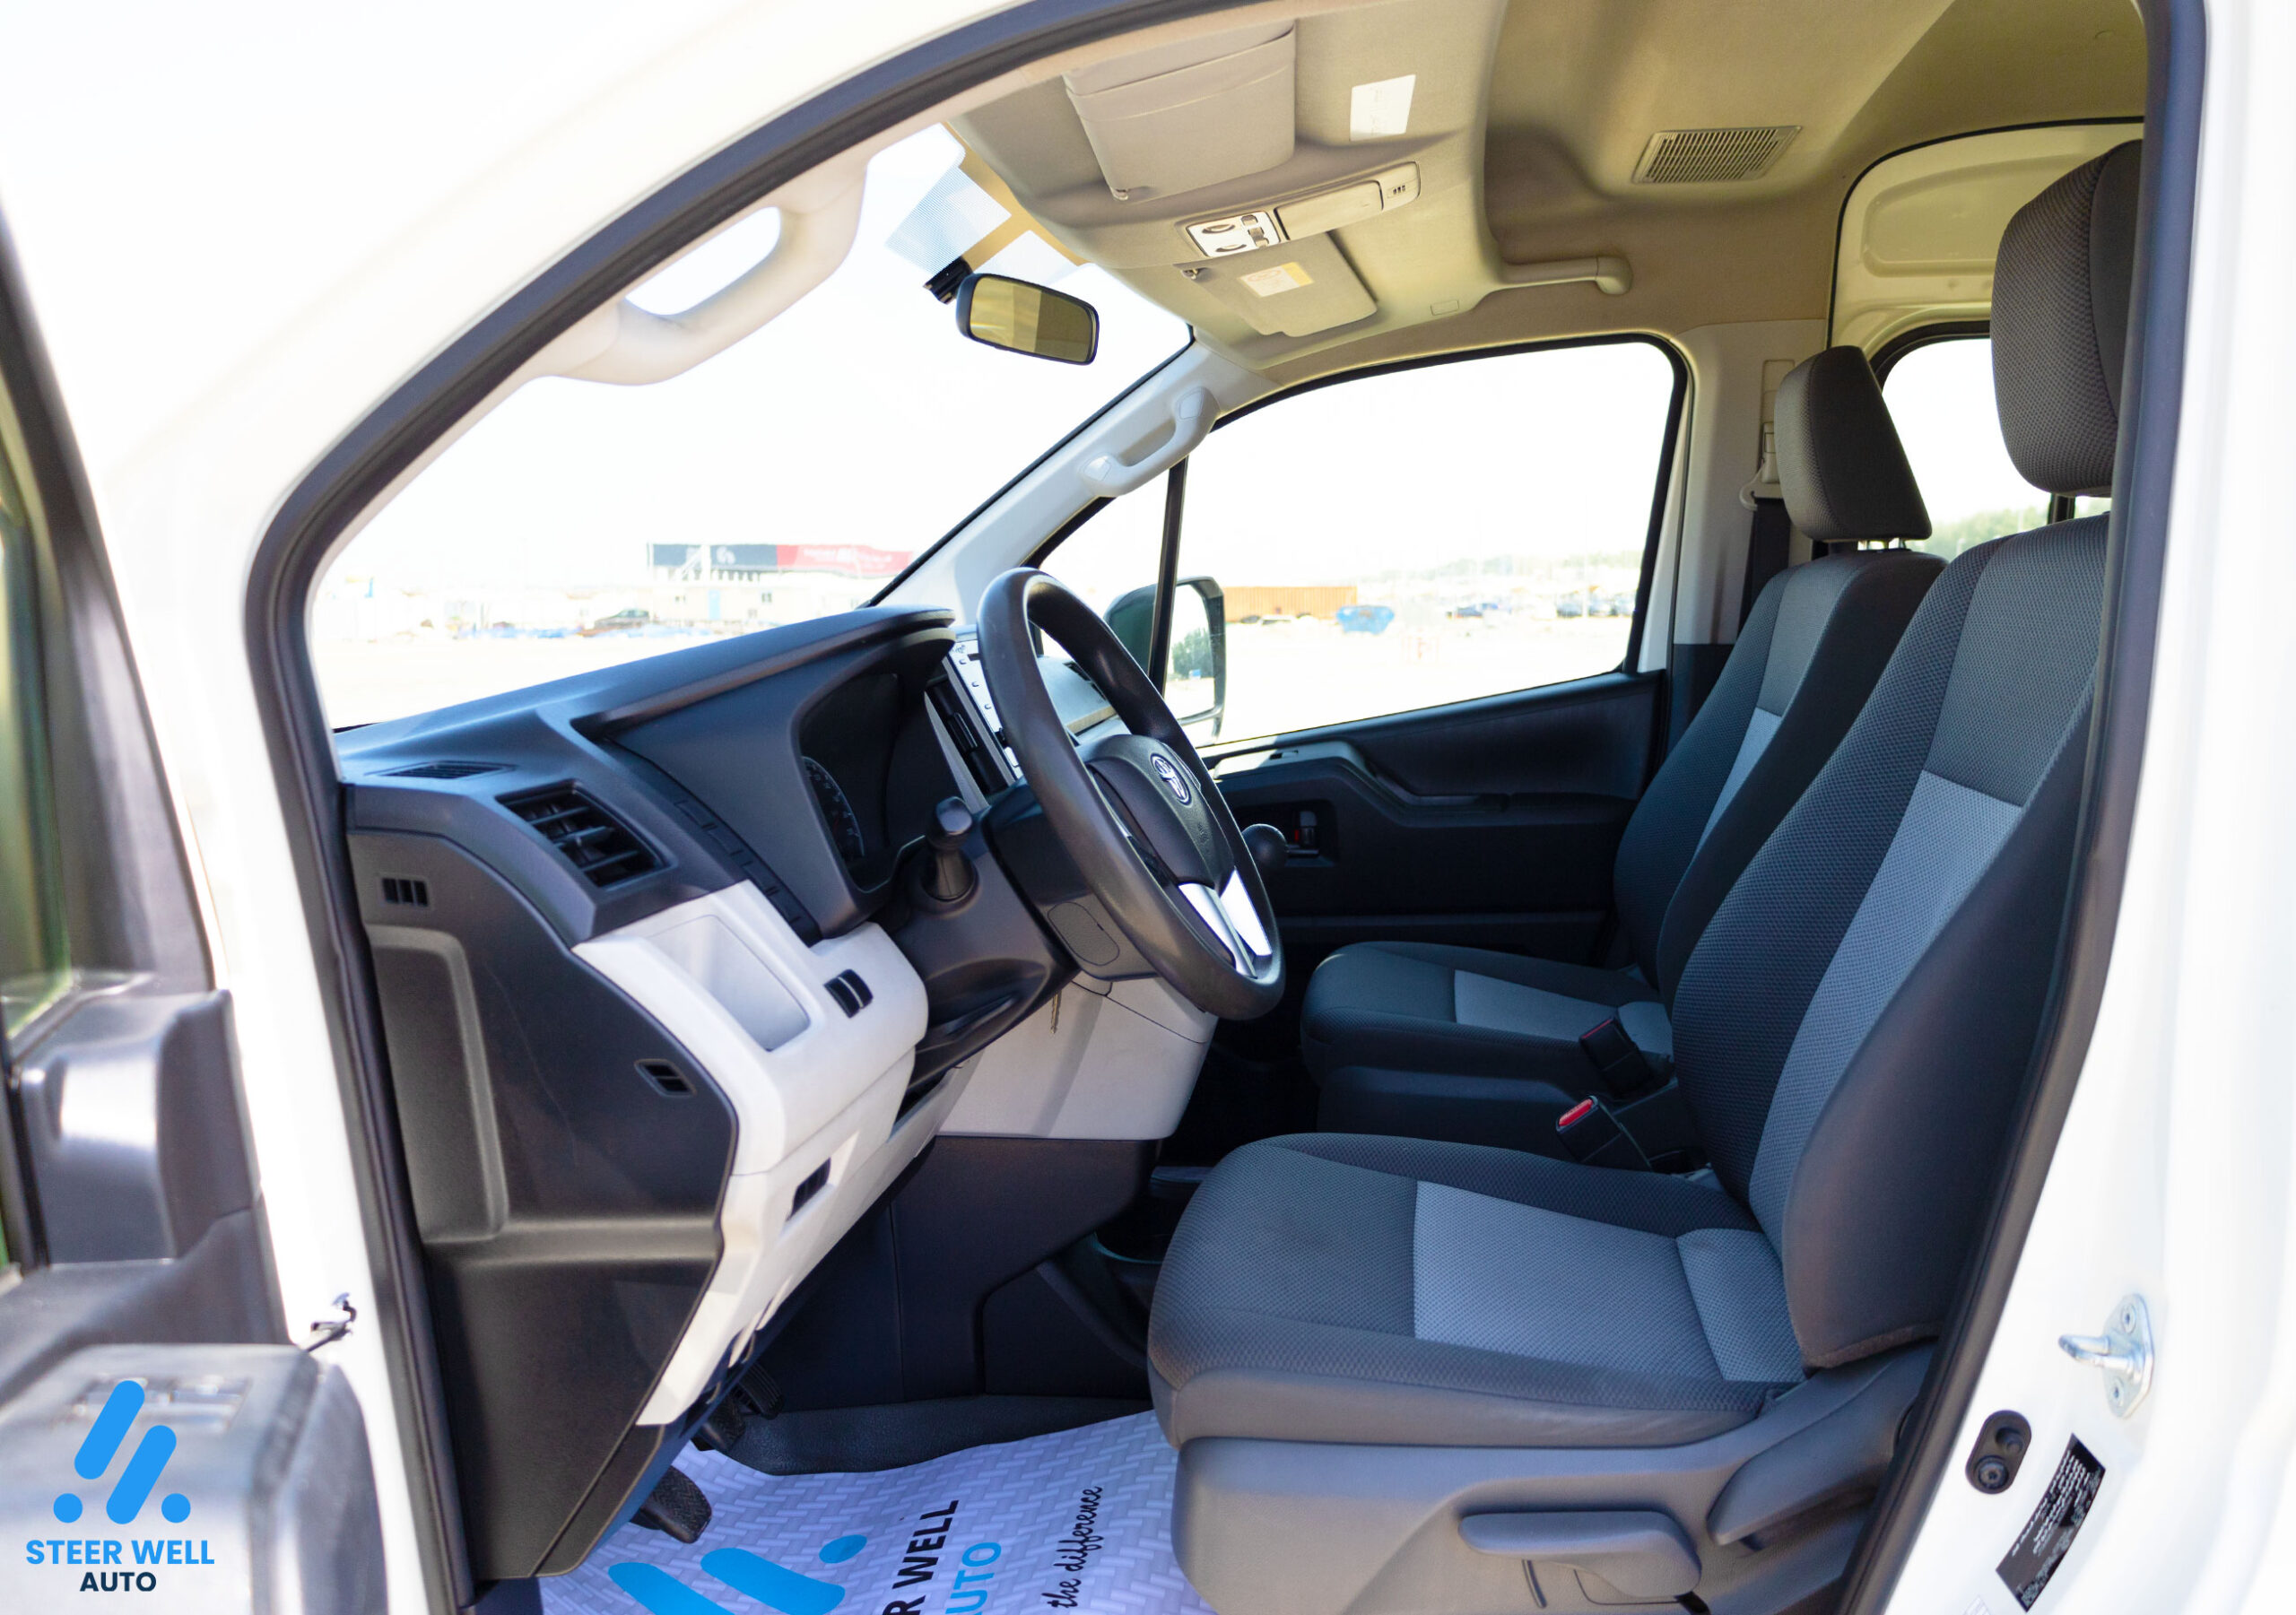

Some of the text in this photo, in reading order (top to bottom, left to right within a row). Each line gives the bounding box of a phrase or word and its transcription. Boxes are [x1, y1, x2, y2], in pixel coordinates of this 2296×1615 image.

[891, 1499, 960, 1590] WELL
[944, 1541, 1003, 1615] UTO
[1040, 1486, 1104, 1609] the difference
